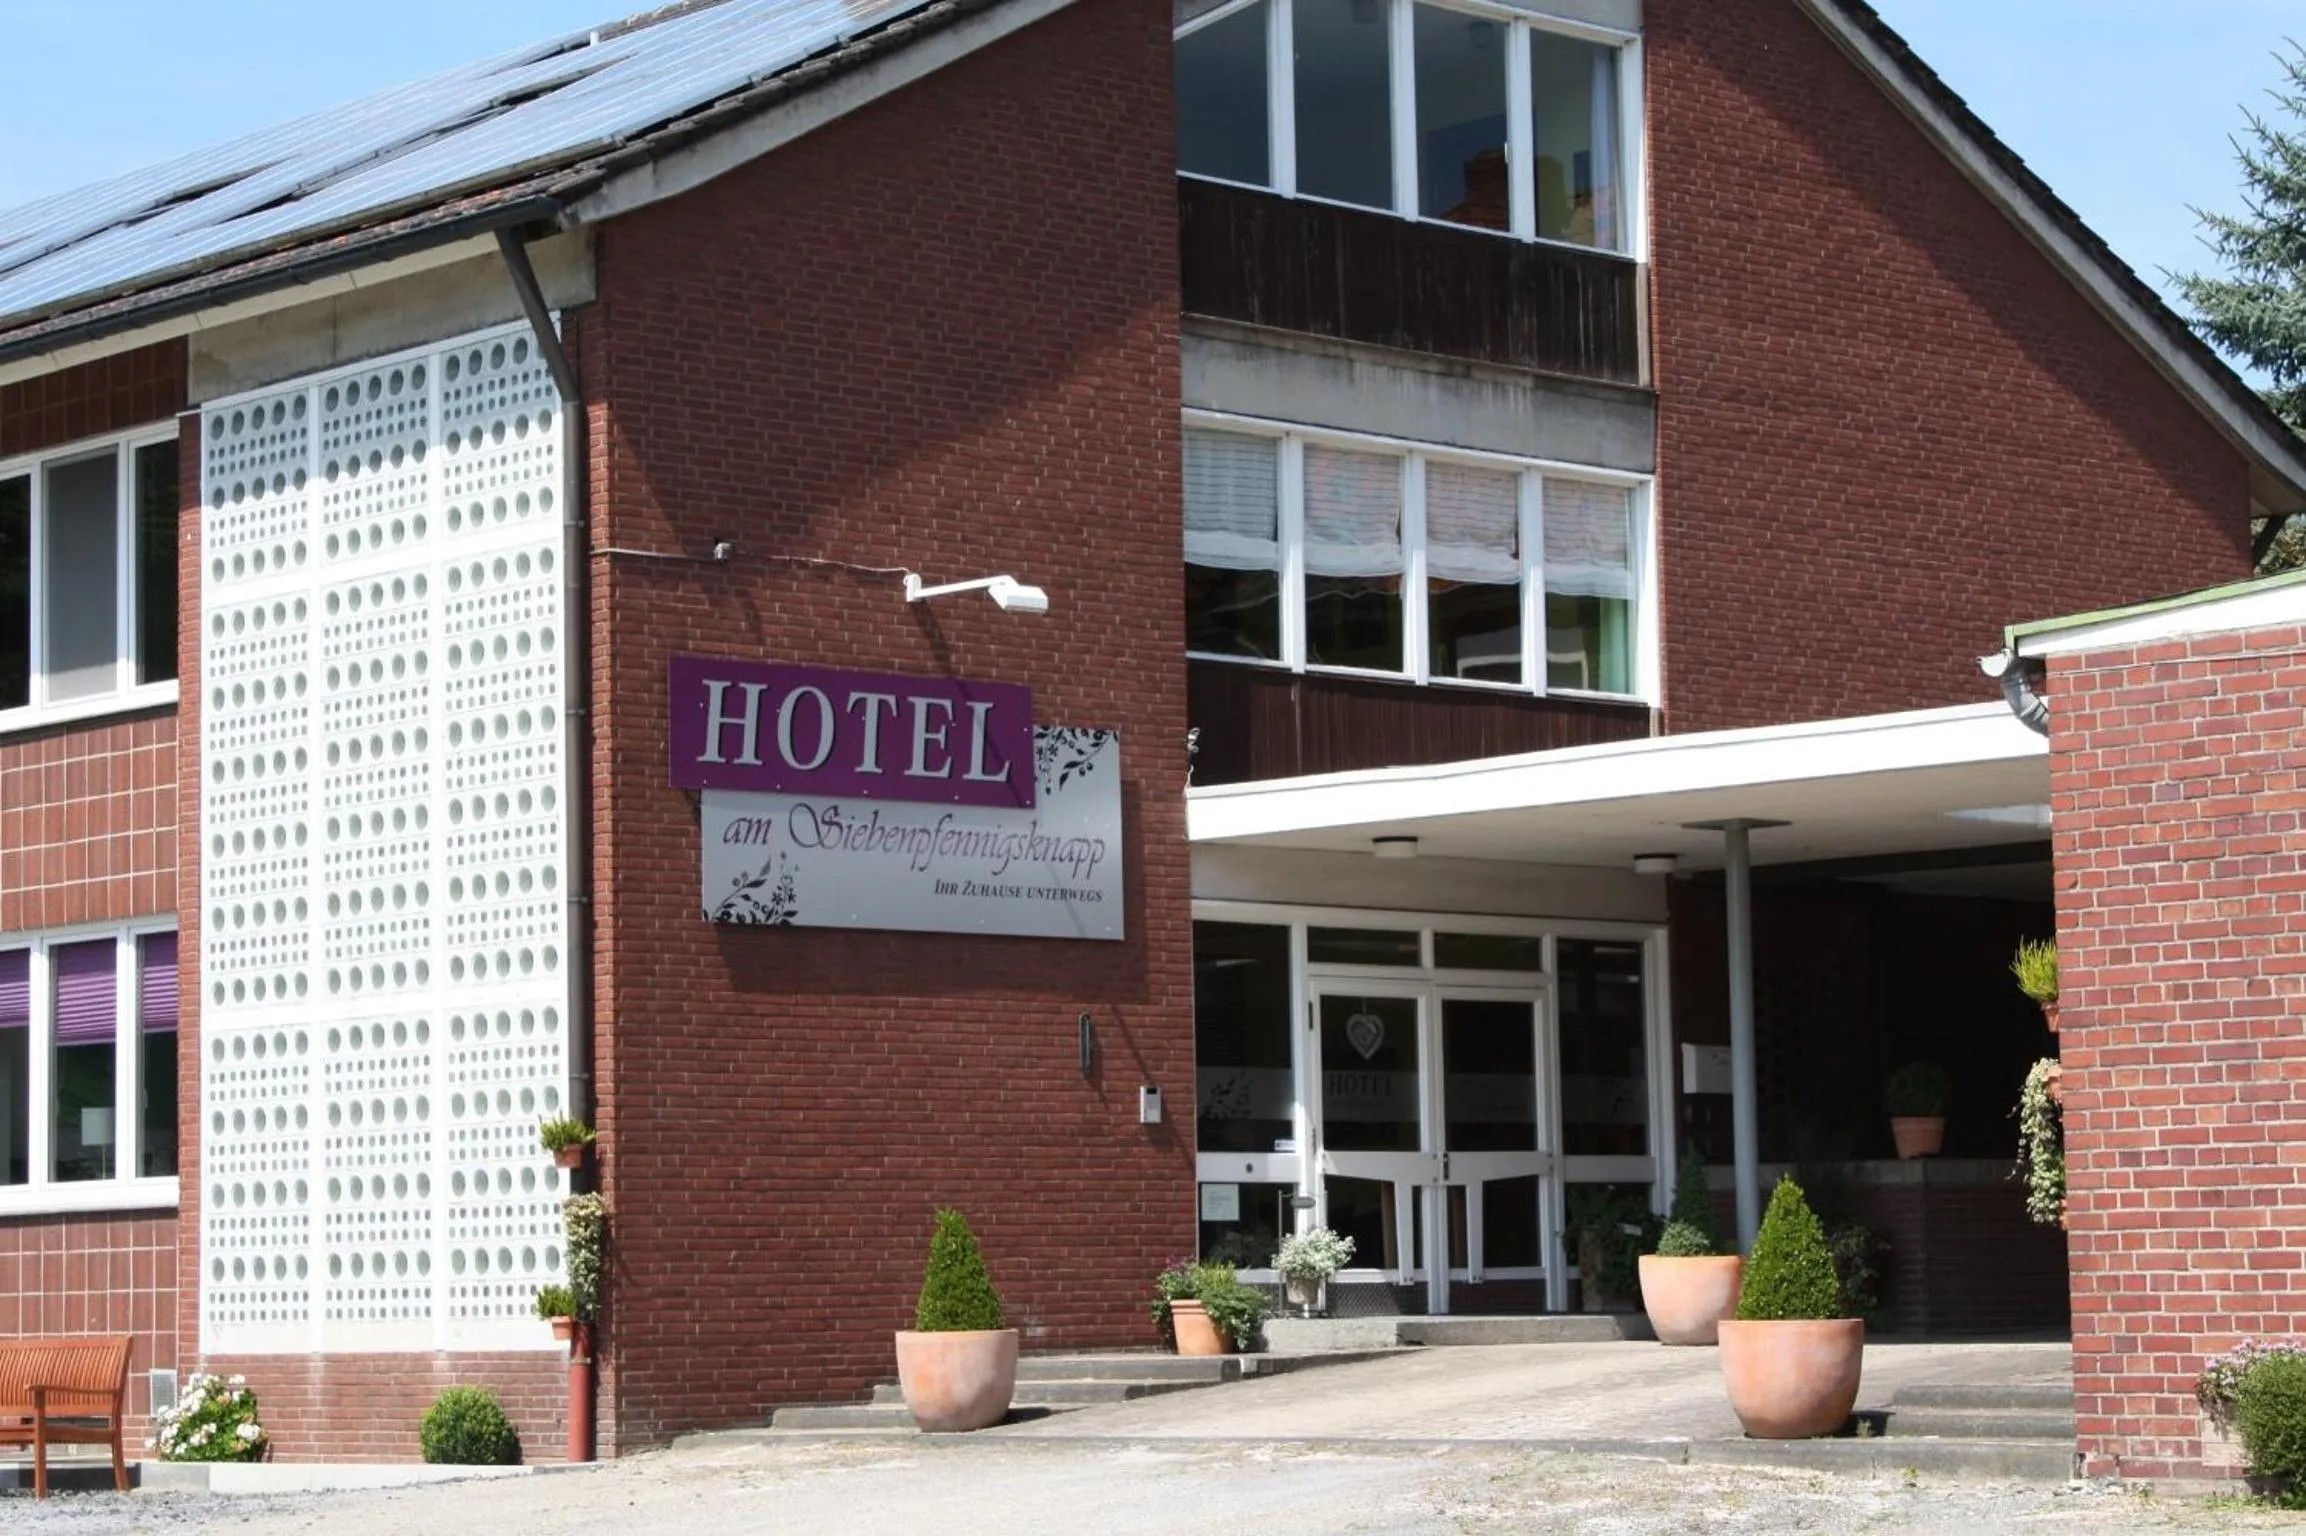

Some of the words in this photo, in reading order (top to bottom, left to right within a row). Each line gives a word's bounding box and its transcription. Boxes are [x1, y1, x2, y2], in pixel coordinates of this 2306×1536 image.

[697, 678, 1012, 784] HOTEL
[722, 816, 773, 846] am
[788, 802, 1106, 881] Siebenpfennigsknapp
[1026, 885, 1104, 903] UNTERWEGS
[1328, 1072, 1395, 1097] HOTEL
